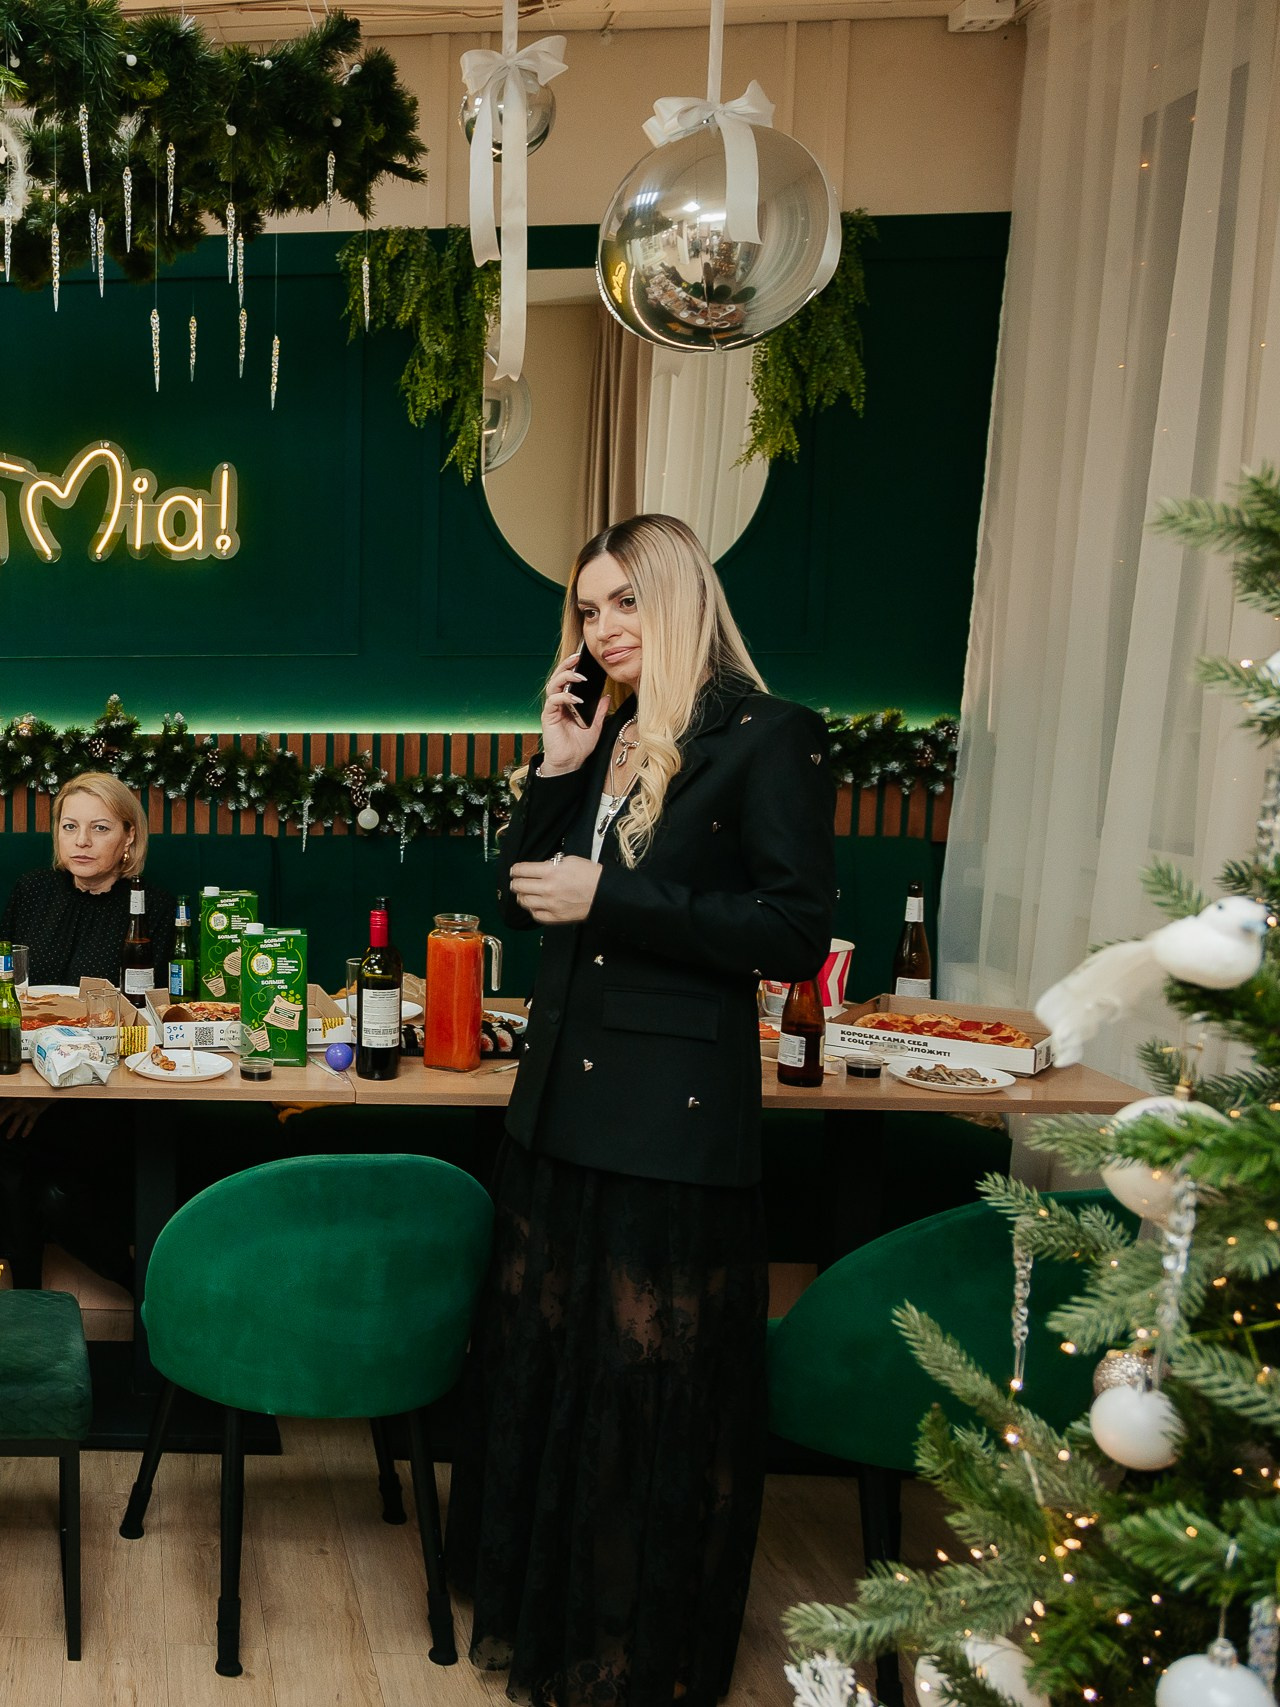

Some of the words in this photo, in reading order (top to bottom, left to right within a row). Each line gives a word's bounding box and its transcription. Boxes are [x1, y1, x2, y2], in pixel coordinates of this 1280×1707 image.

[26, 447, 231, 557] Mia!
[840, 1030, 880, 1041] КОРОБКА
[882, 1036, 906, 1044] САМА
[907, 1039, 928, 1047] СЕБЯ
